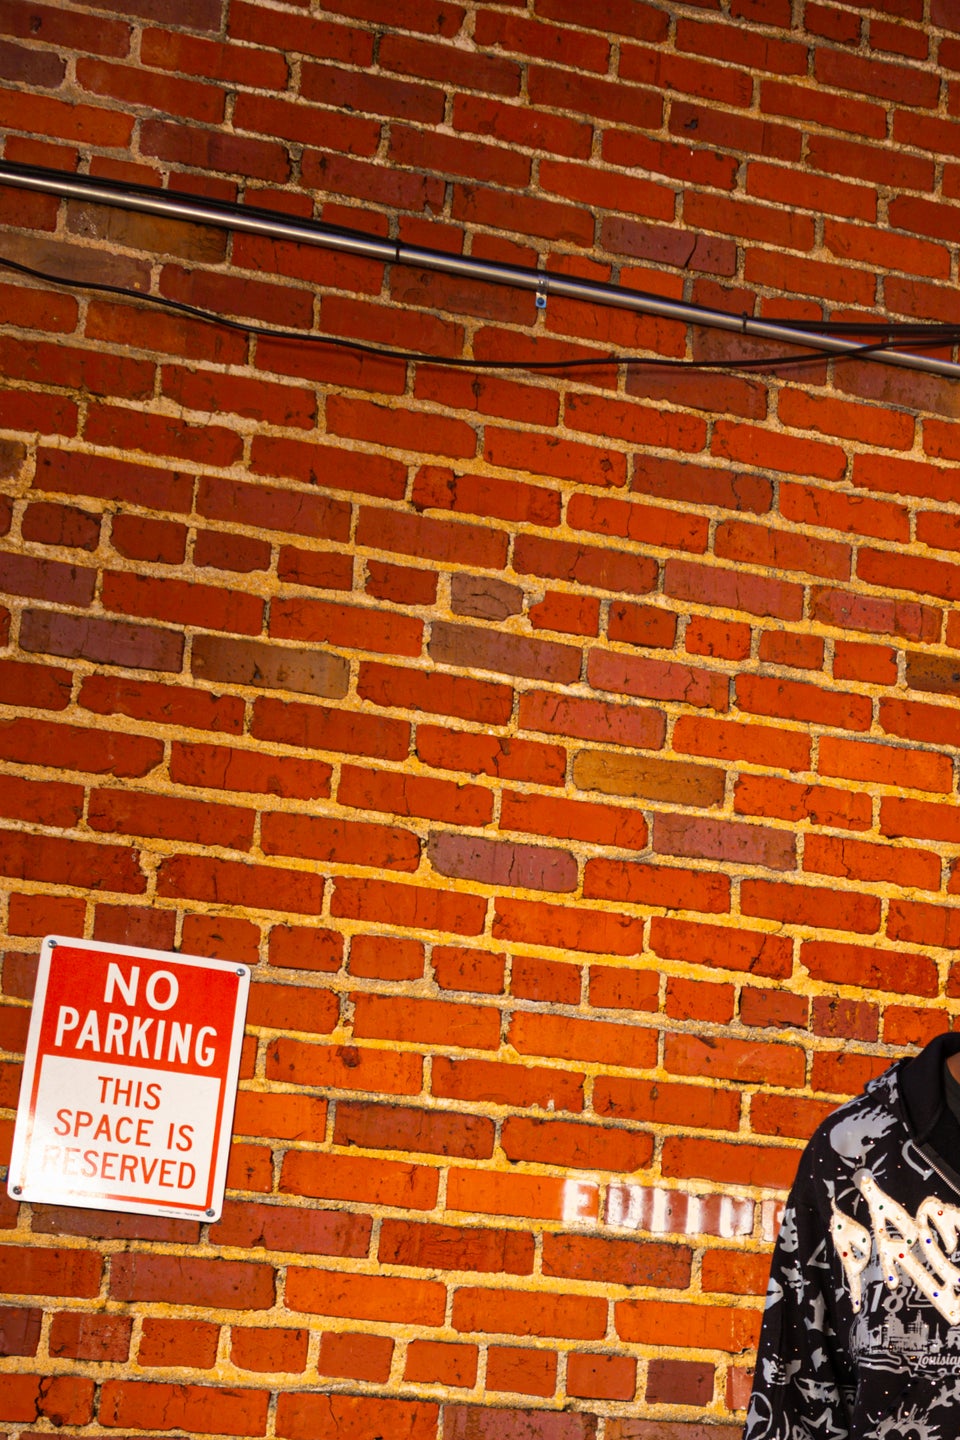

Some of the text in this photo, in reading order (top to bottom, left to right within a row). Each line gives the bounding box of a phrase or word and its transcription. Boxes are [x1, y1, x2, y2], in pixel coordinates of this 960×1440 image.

[103, 962, 180, 1012] NO
[54, 1005, 218, 1068] PARKING
[98, 1076, 162, 1111] THIS
[54, 1108, 194, 1152] SPACE IS
[42, 1145, 196, 1189] RESERVED
